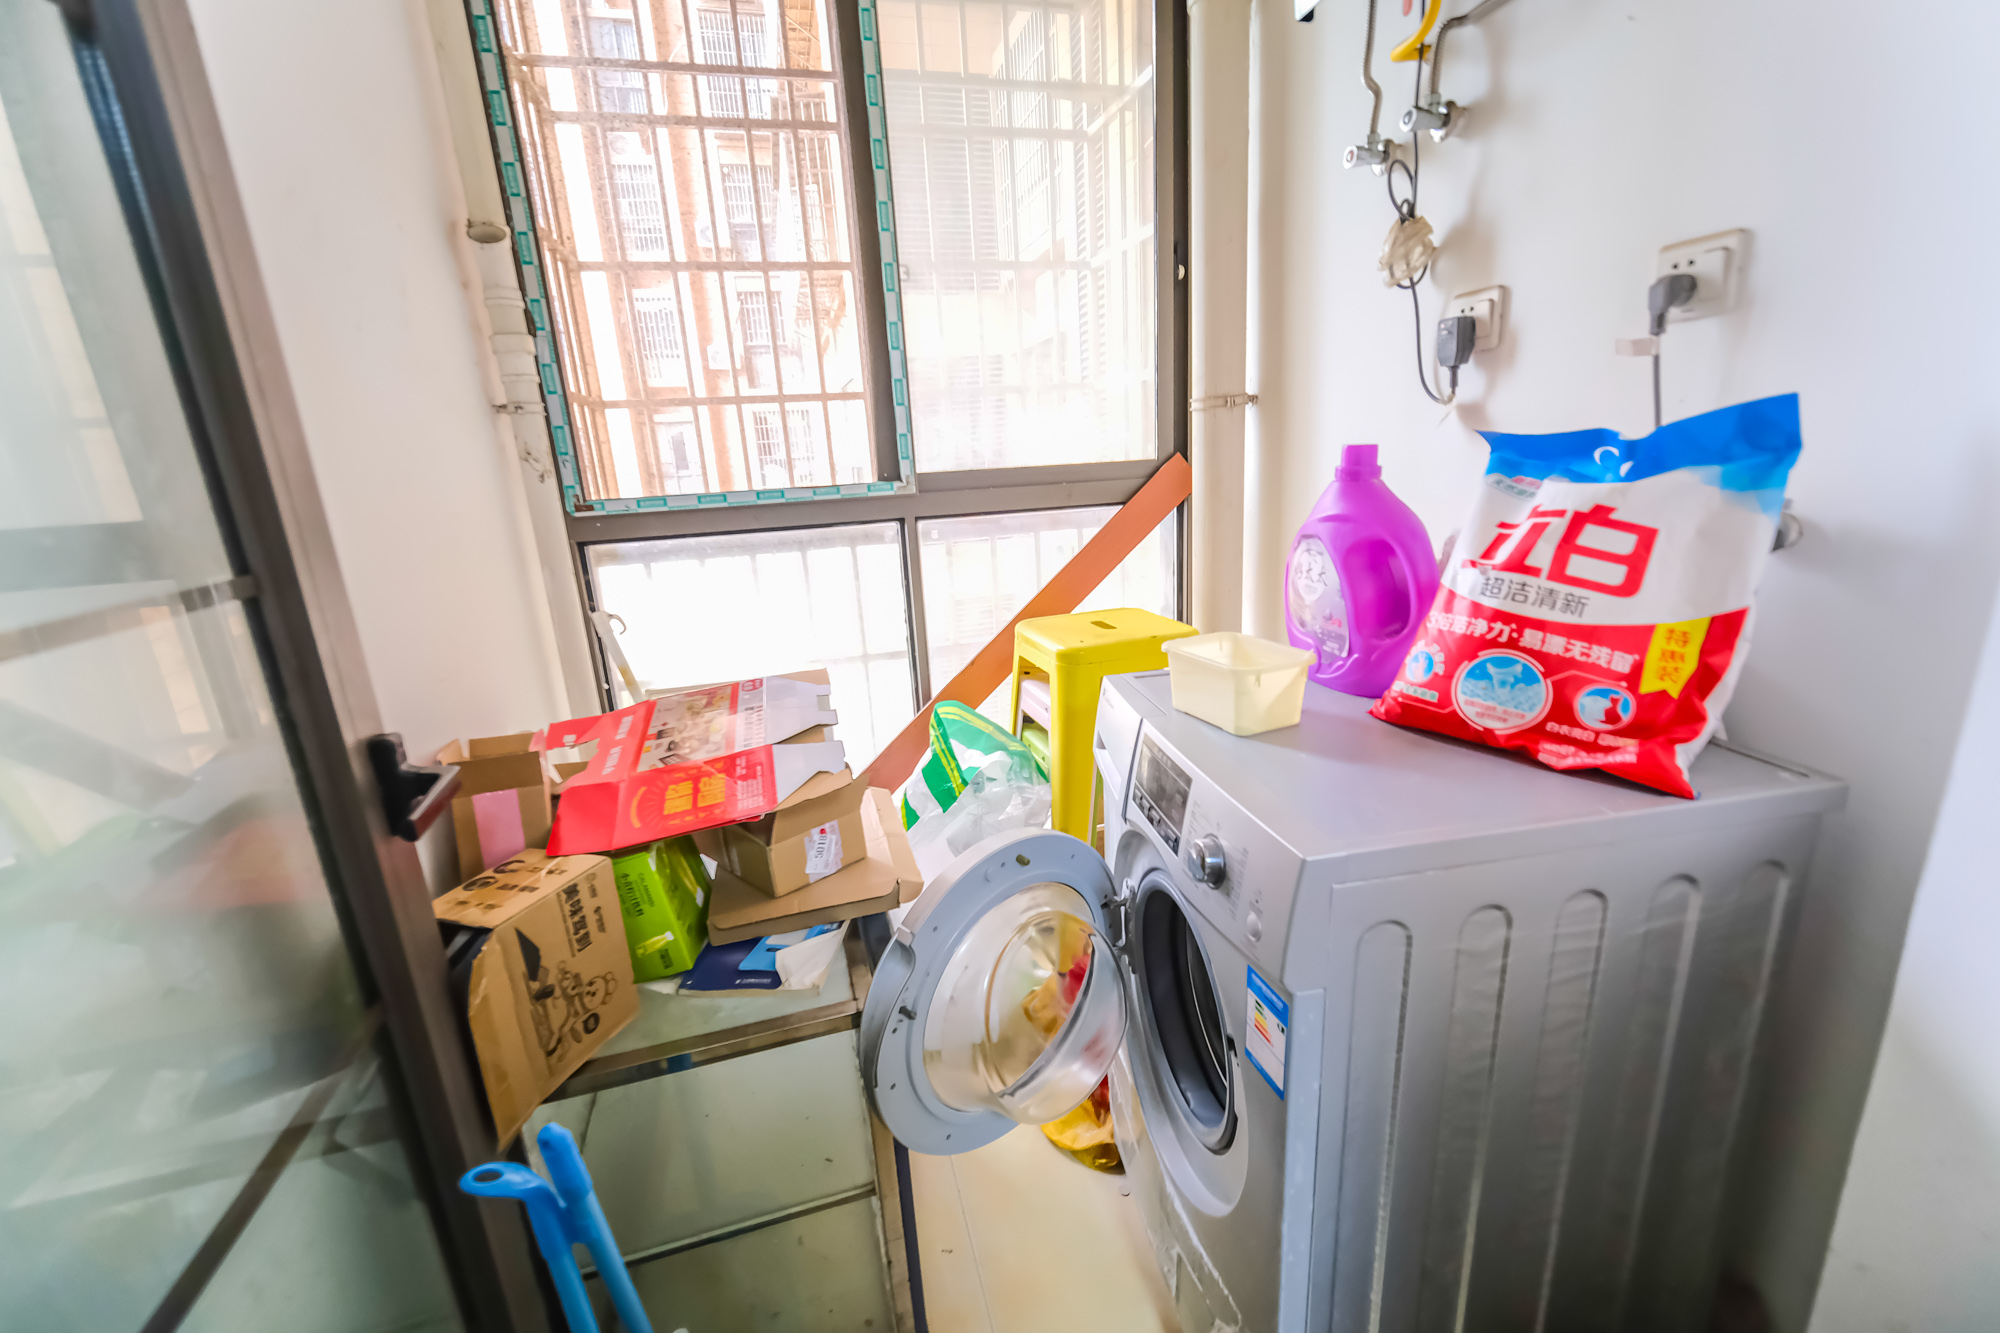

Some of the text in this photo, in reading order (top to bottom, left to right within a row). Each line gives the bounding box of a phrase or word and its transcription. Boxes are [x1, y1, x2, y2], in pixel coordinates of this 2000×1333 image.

[1480, 575, 1591, 618] 超洁清新
[562, 882, 593, 953] 美味驾到
